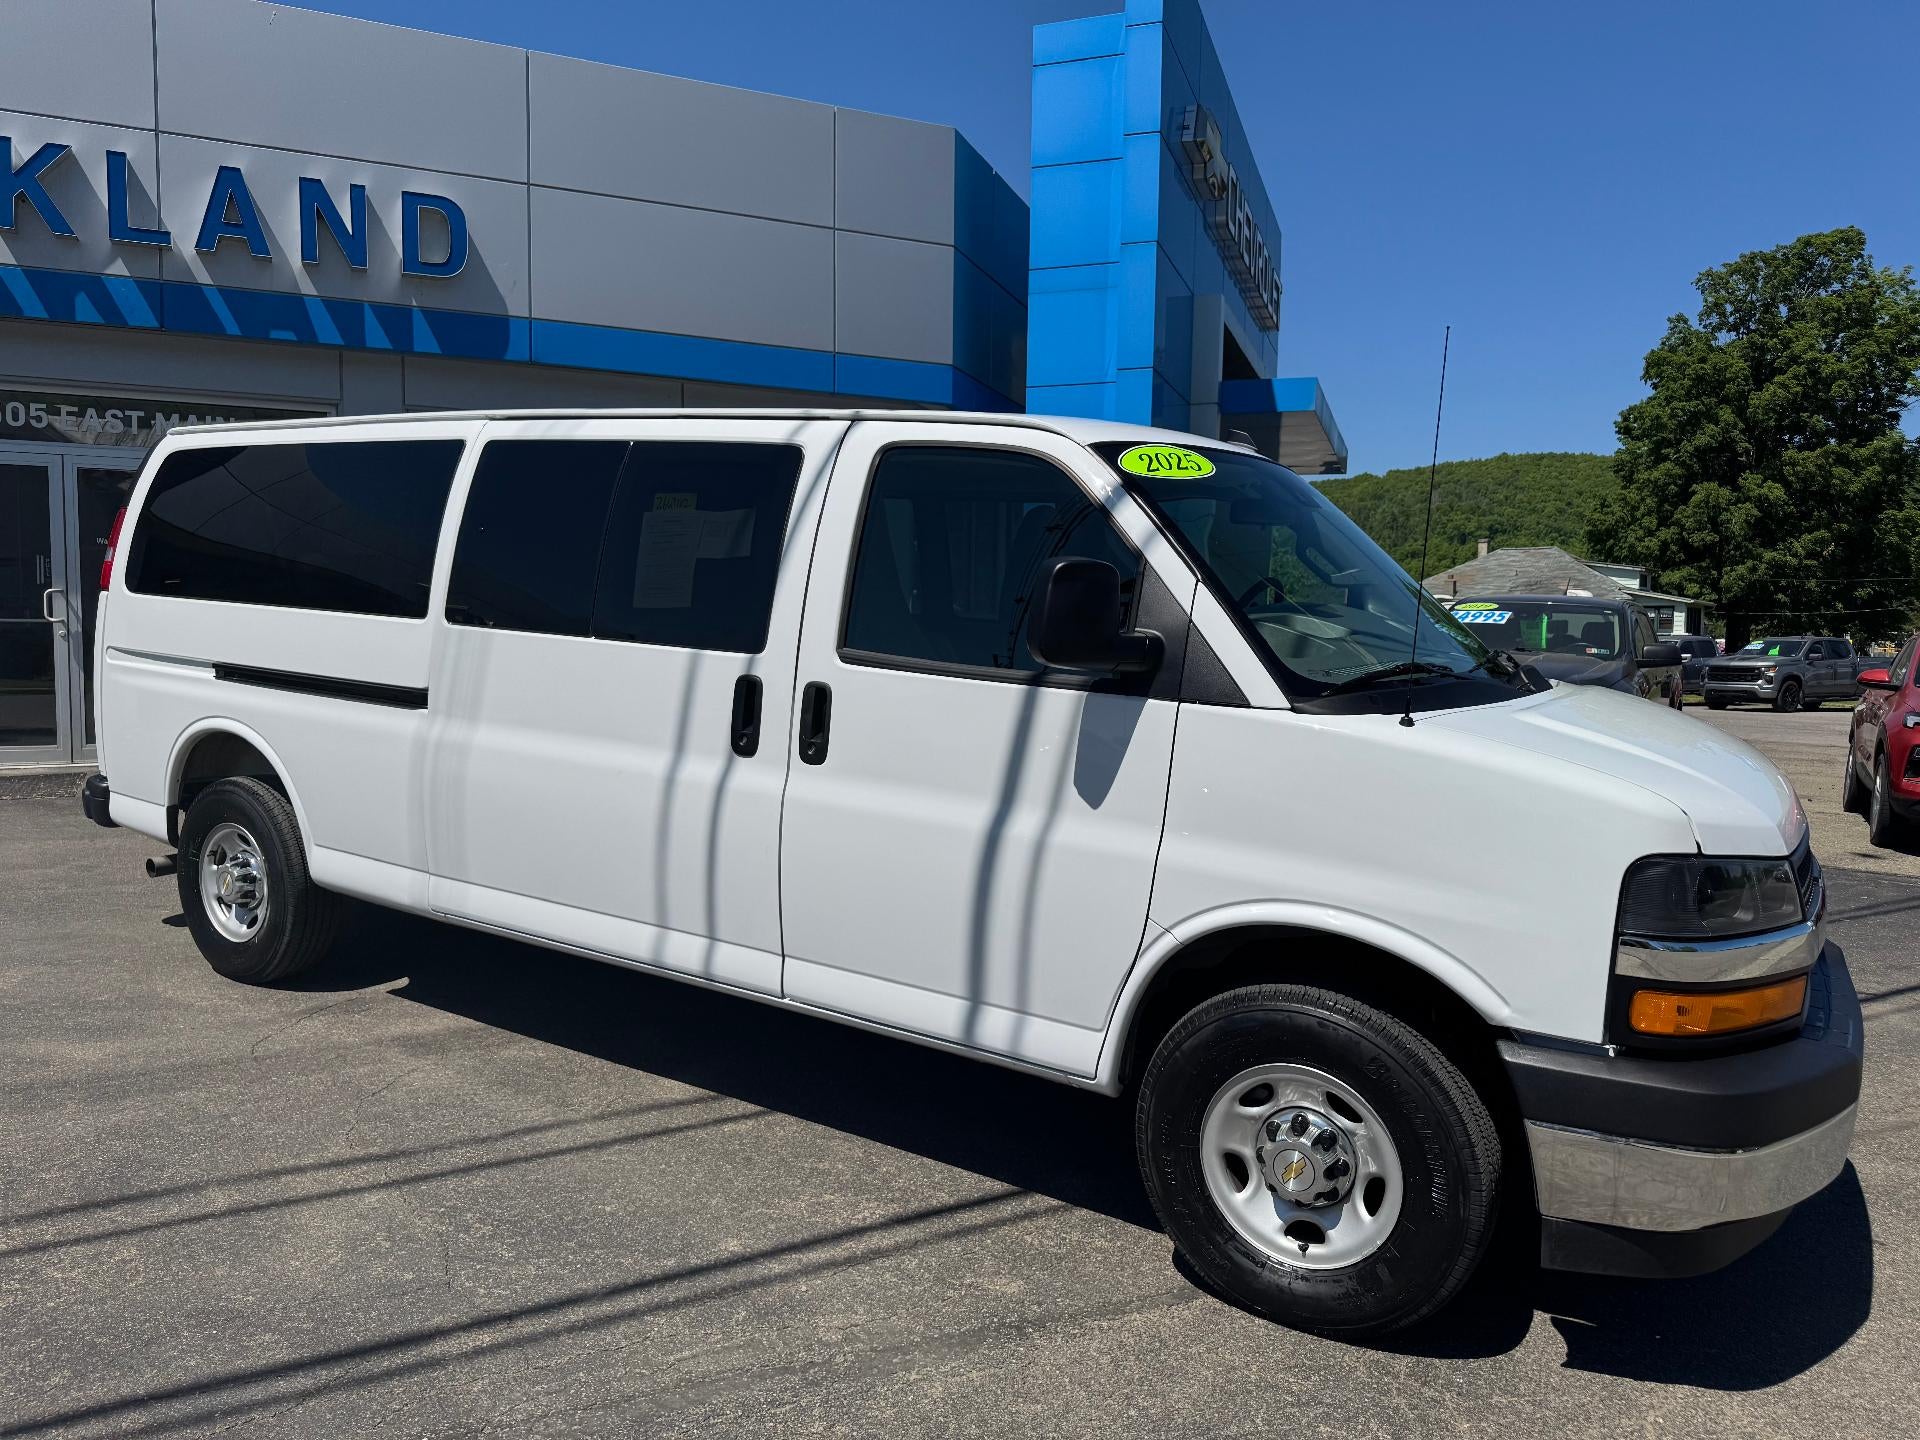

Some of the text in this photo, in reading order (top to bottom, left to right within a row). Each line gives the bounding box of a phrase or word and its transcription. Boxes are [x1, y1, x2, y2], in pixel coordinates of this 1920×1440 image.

[0, 136, 469, 278] KLAND
[1227, 163, 1282, 331] CHEVROLET
[0, 401, 49, 428] 05
[60, 404, 145, 434] EAST
[1138, 452, 1202, 473] 2025
